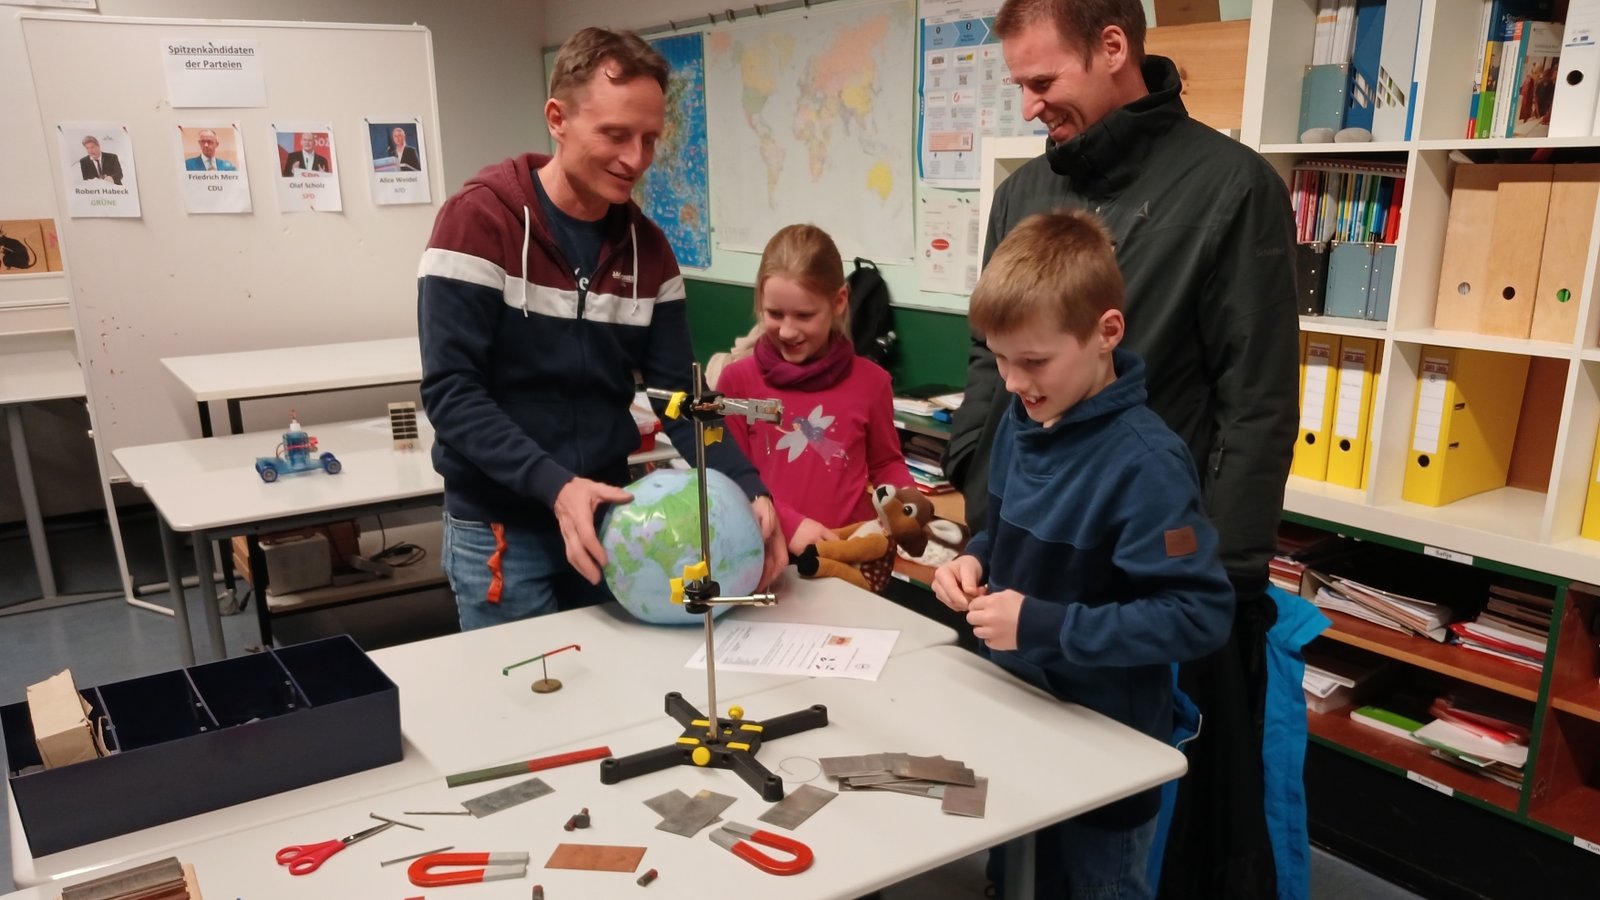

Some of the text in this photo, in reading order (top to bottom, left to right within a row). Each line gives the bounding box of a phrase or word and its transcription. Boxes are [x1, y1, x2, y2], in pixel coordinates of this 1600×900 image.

[168, 45, 255, 56] Spitzenkandidaten
[185, 60, 243, 70] der Parteien
